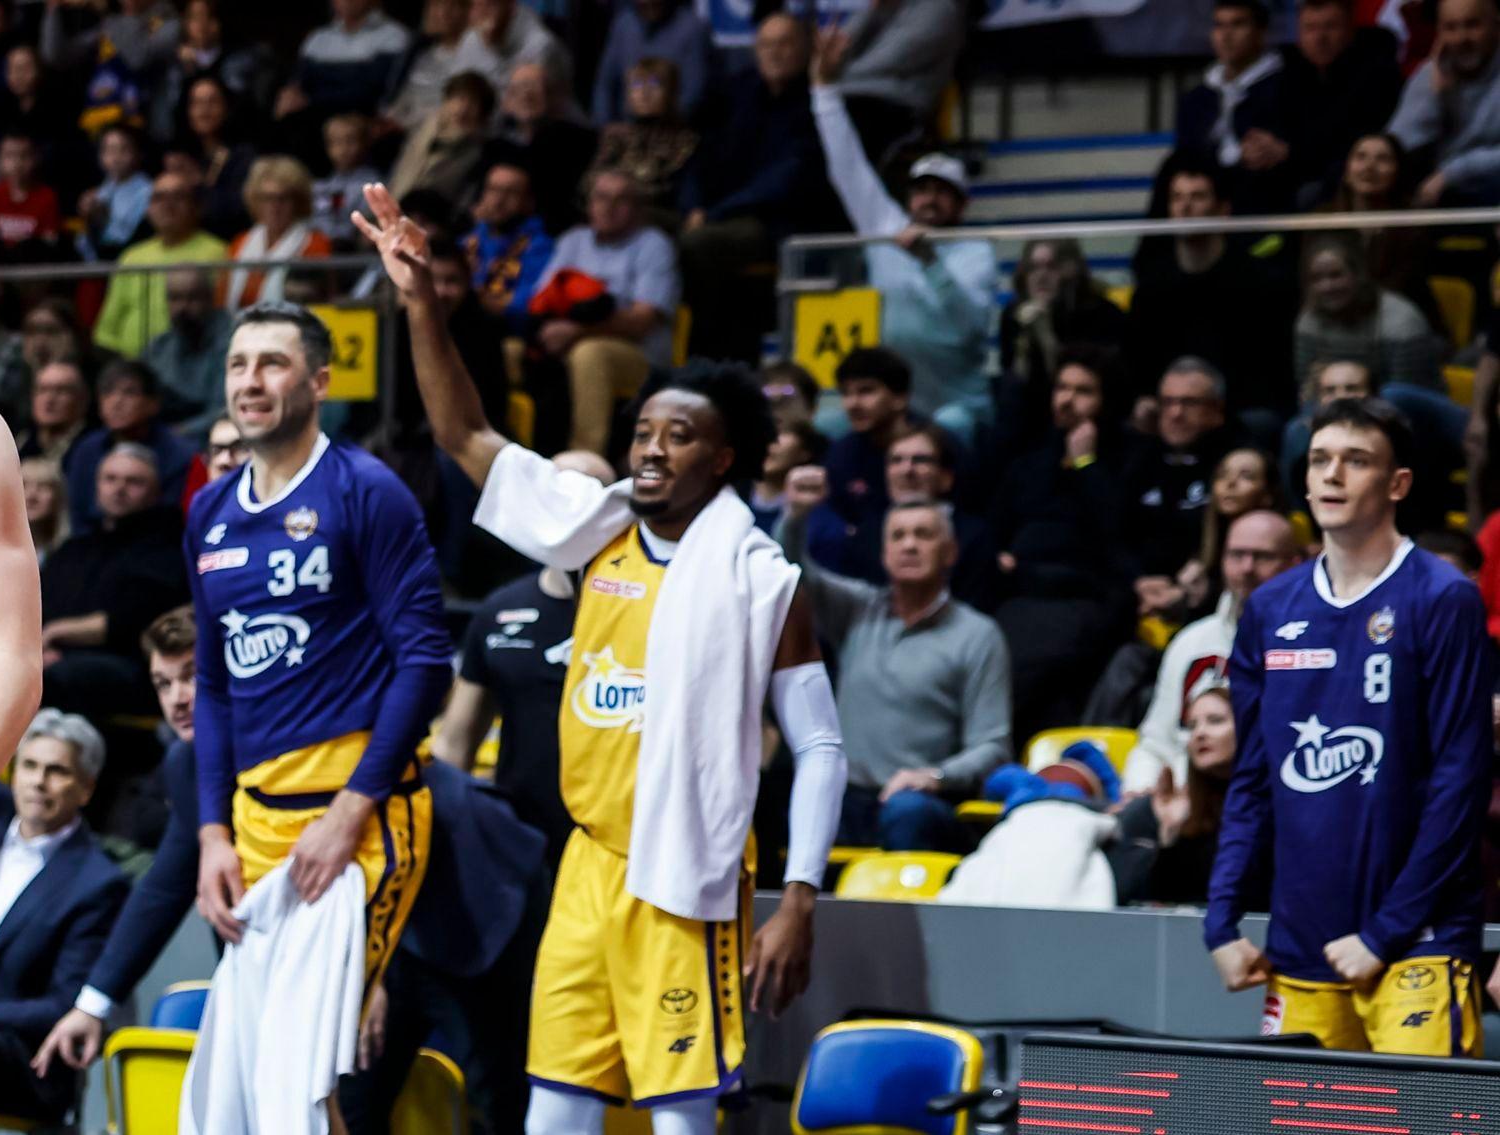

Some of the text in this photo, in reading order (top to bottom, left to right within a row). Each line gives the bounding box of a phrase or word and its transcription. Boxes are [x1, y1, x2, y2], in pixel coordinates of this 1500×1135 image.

[267, 545, 333, 597] 34
[233, 625, 289, 667] LOTTO
[1364, 652, 1392, 704] 8
[1304, 738, 1366, 780] LOTTO
